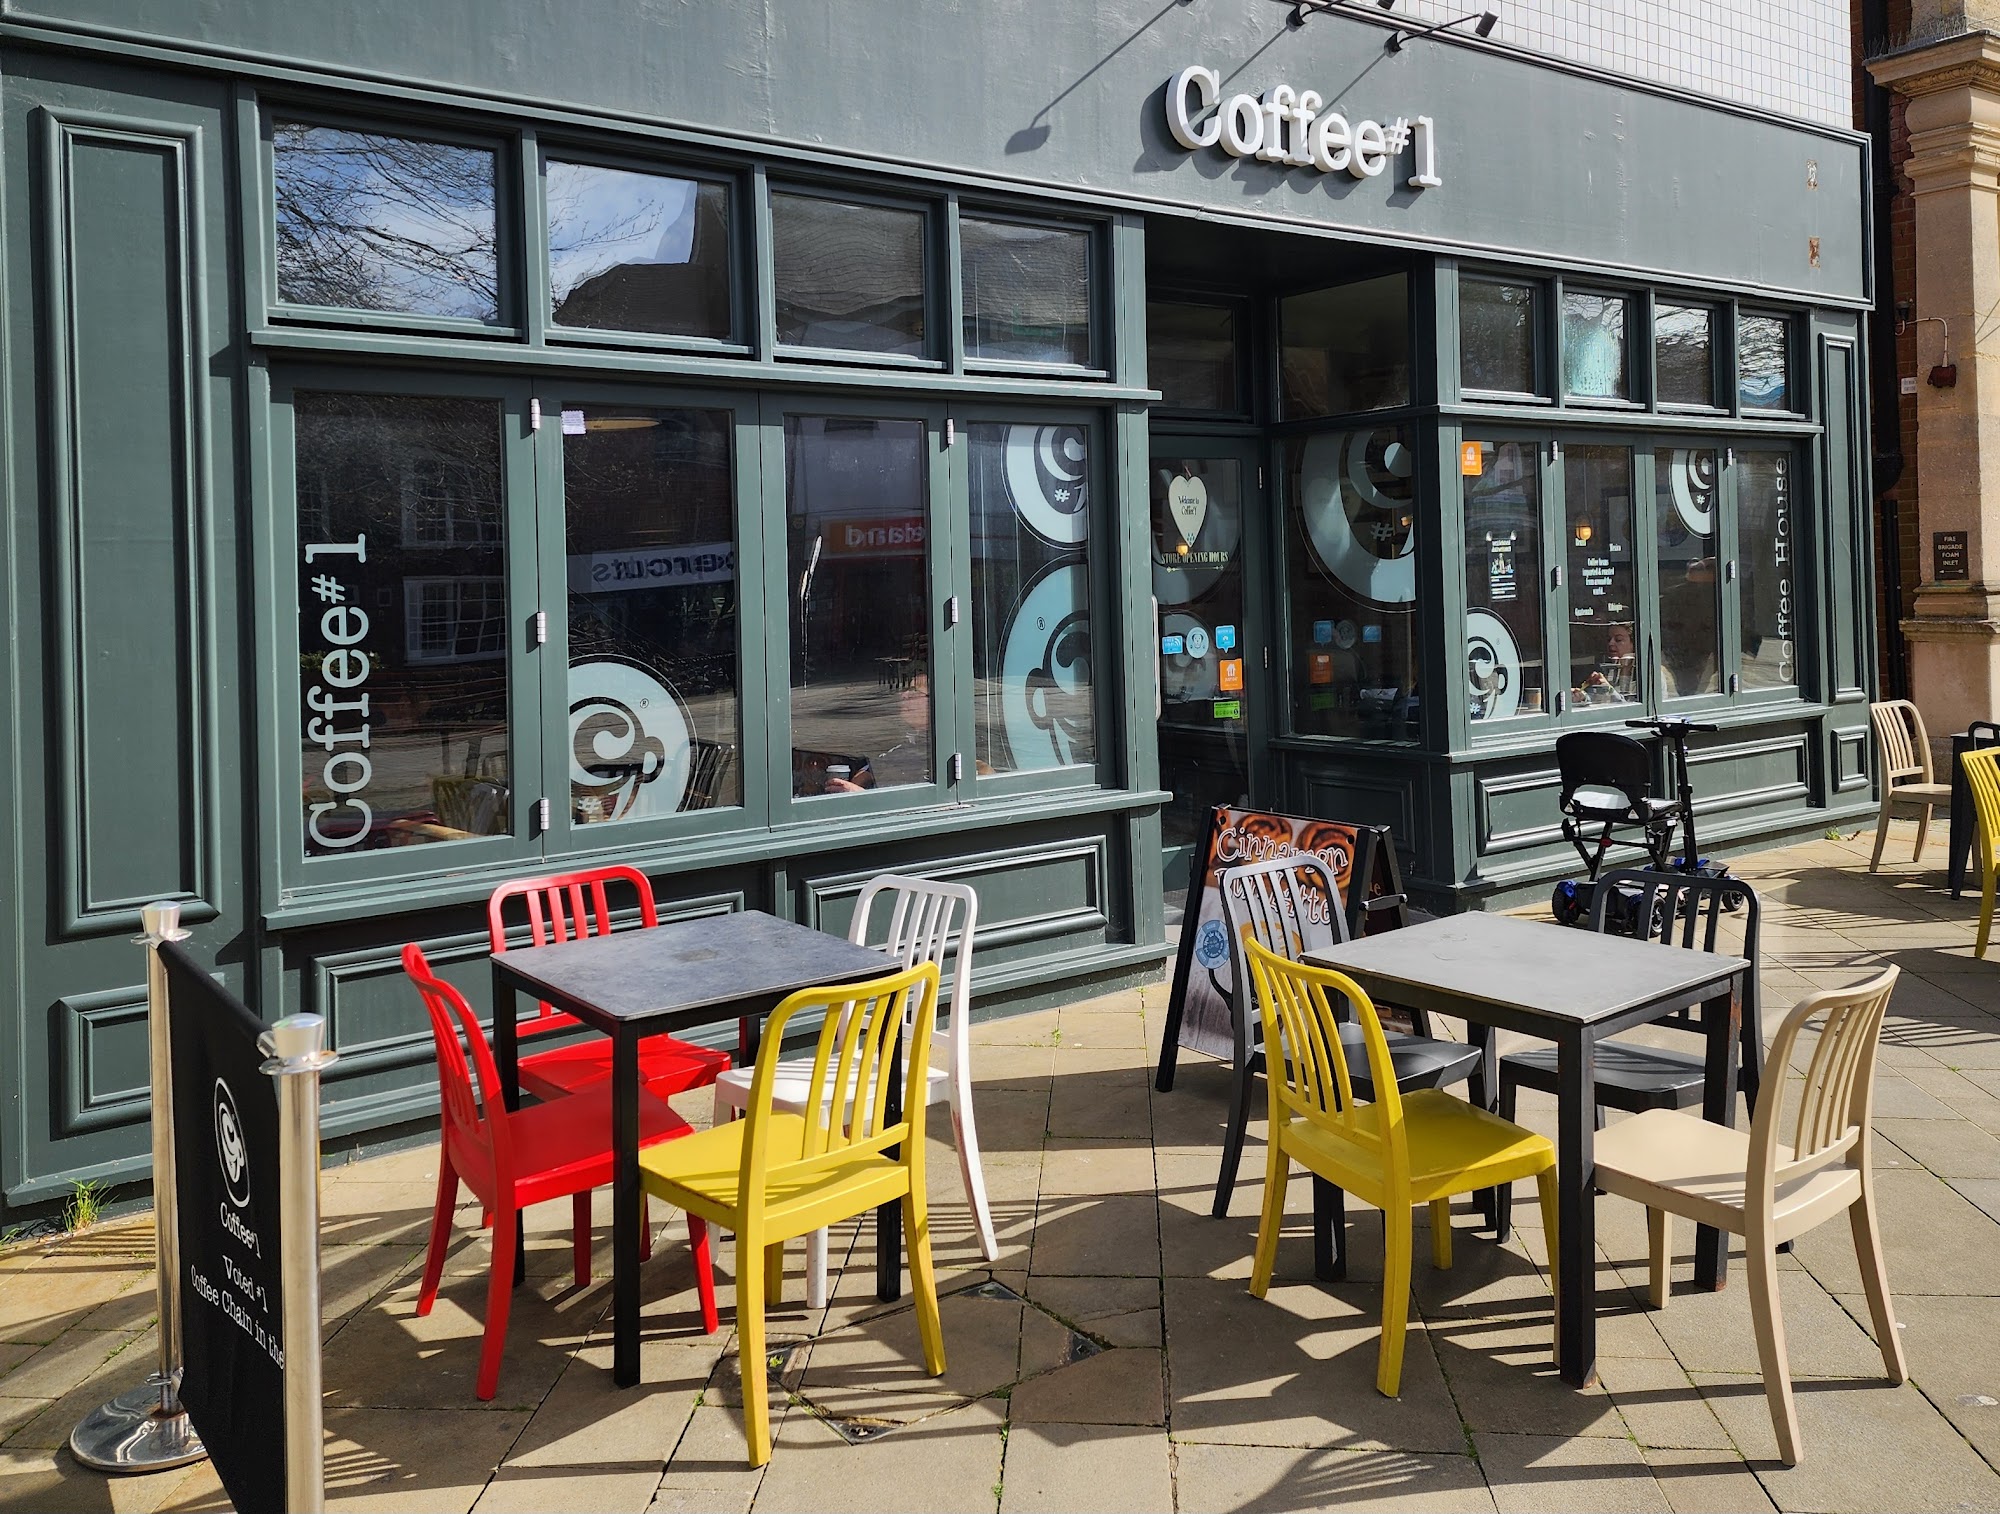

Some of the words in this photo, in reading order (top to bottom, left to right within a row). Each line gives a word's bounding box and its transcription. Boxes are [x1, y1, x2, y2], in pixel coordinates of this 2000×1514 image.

[1161, 553, 1180, 564] STORE
[1182, 552, 1208, 563] OPENING
[1209, 551, 1228, 562] HOURS
[1775, 457, 1790, 567] House
[1778, 579, 1794, 682] Coffee
[191, 1264, 219, 1306] Coffee
[222, 1290, 253, 1336] Chain
[255, 1320, 267, 1350] in
[268, 1334, 284, 1370] the
[222, 1255, 255, 1301] Voted
[256, 1286, 268, 1314] #1
